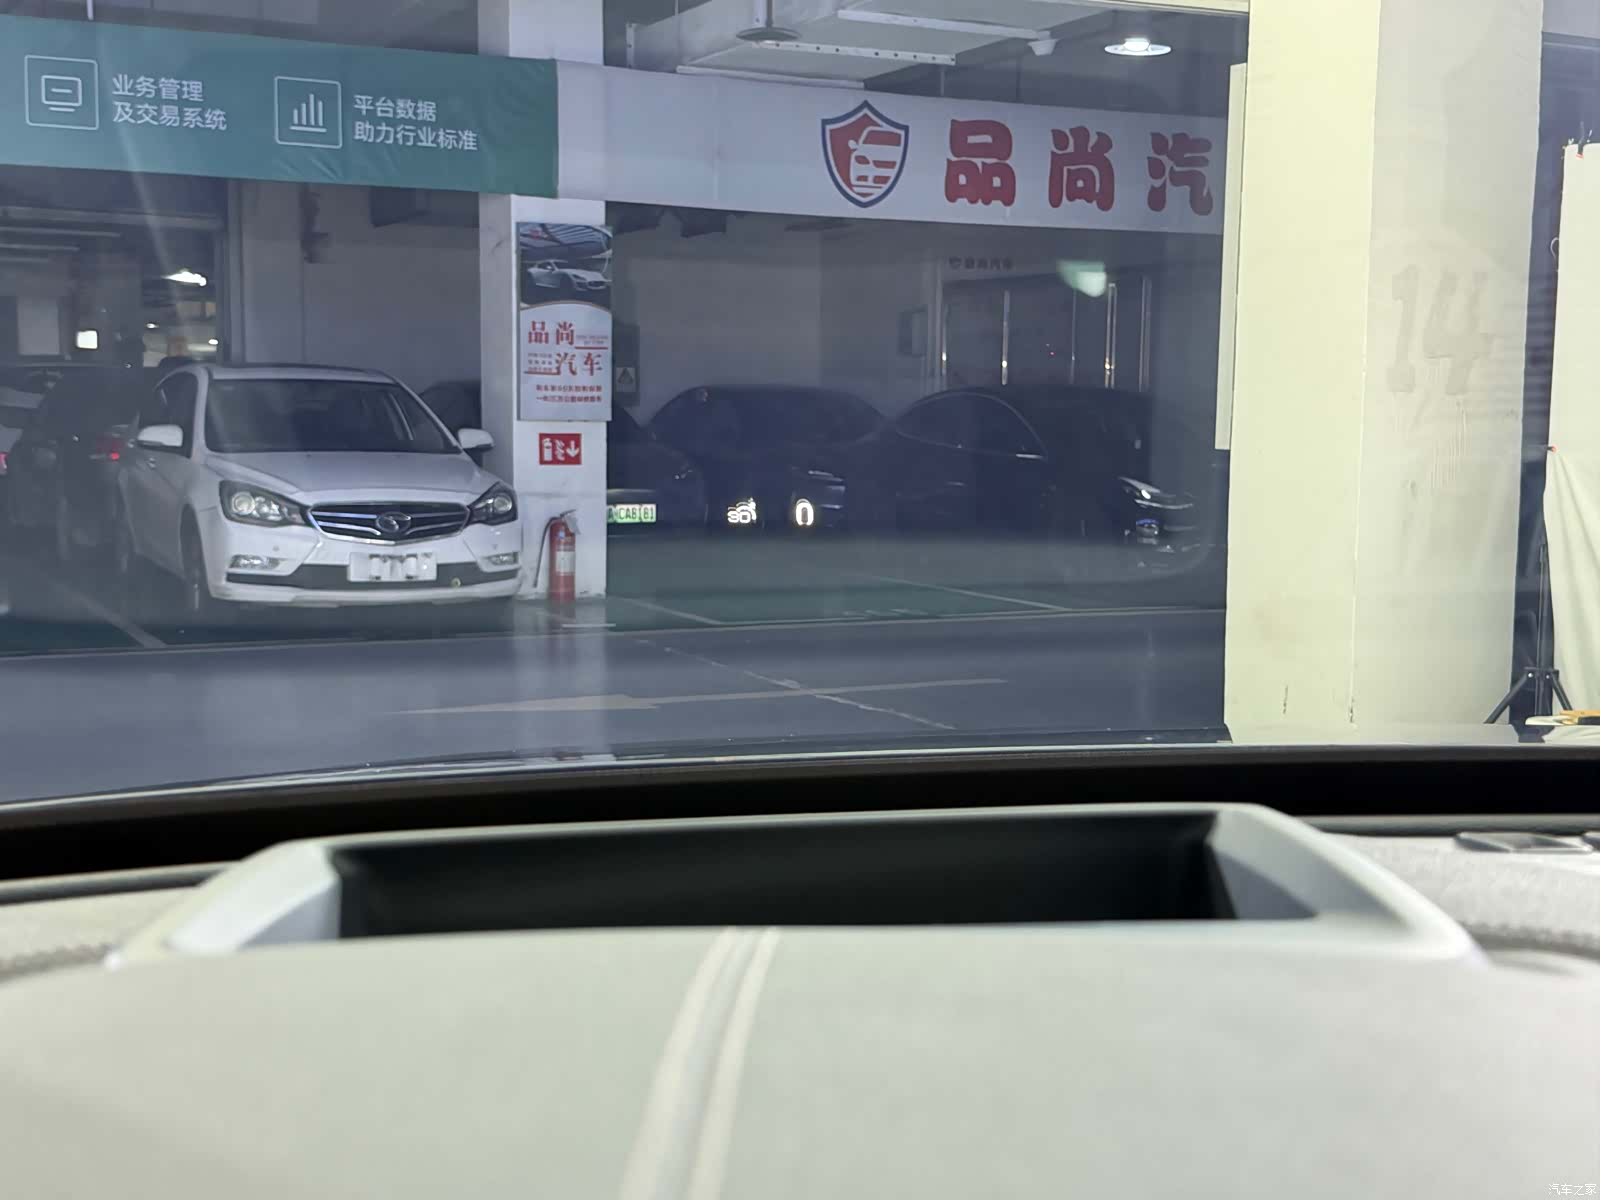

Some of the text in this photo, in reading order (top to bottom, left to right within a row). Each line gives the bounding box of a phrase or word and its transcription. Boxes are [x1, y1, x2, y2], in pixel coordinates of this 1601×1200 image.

[112, 74, 204, 102] 业务管理
[113, 101, 227, 131] 及交易系统
[353, 93, 438, 122] 平台数据
[353, 121, 477, 152] 助力行业标准
[944, 118, 1214, 216] 品尚汽
[528, 321, 575, 346] 品尚
[1389, 266, 1493, 394] 14
[555, 352, 603, 376] 汽车
